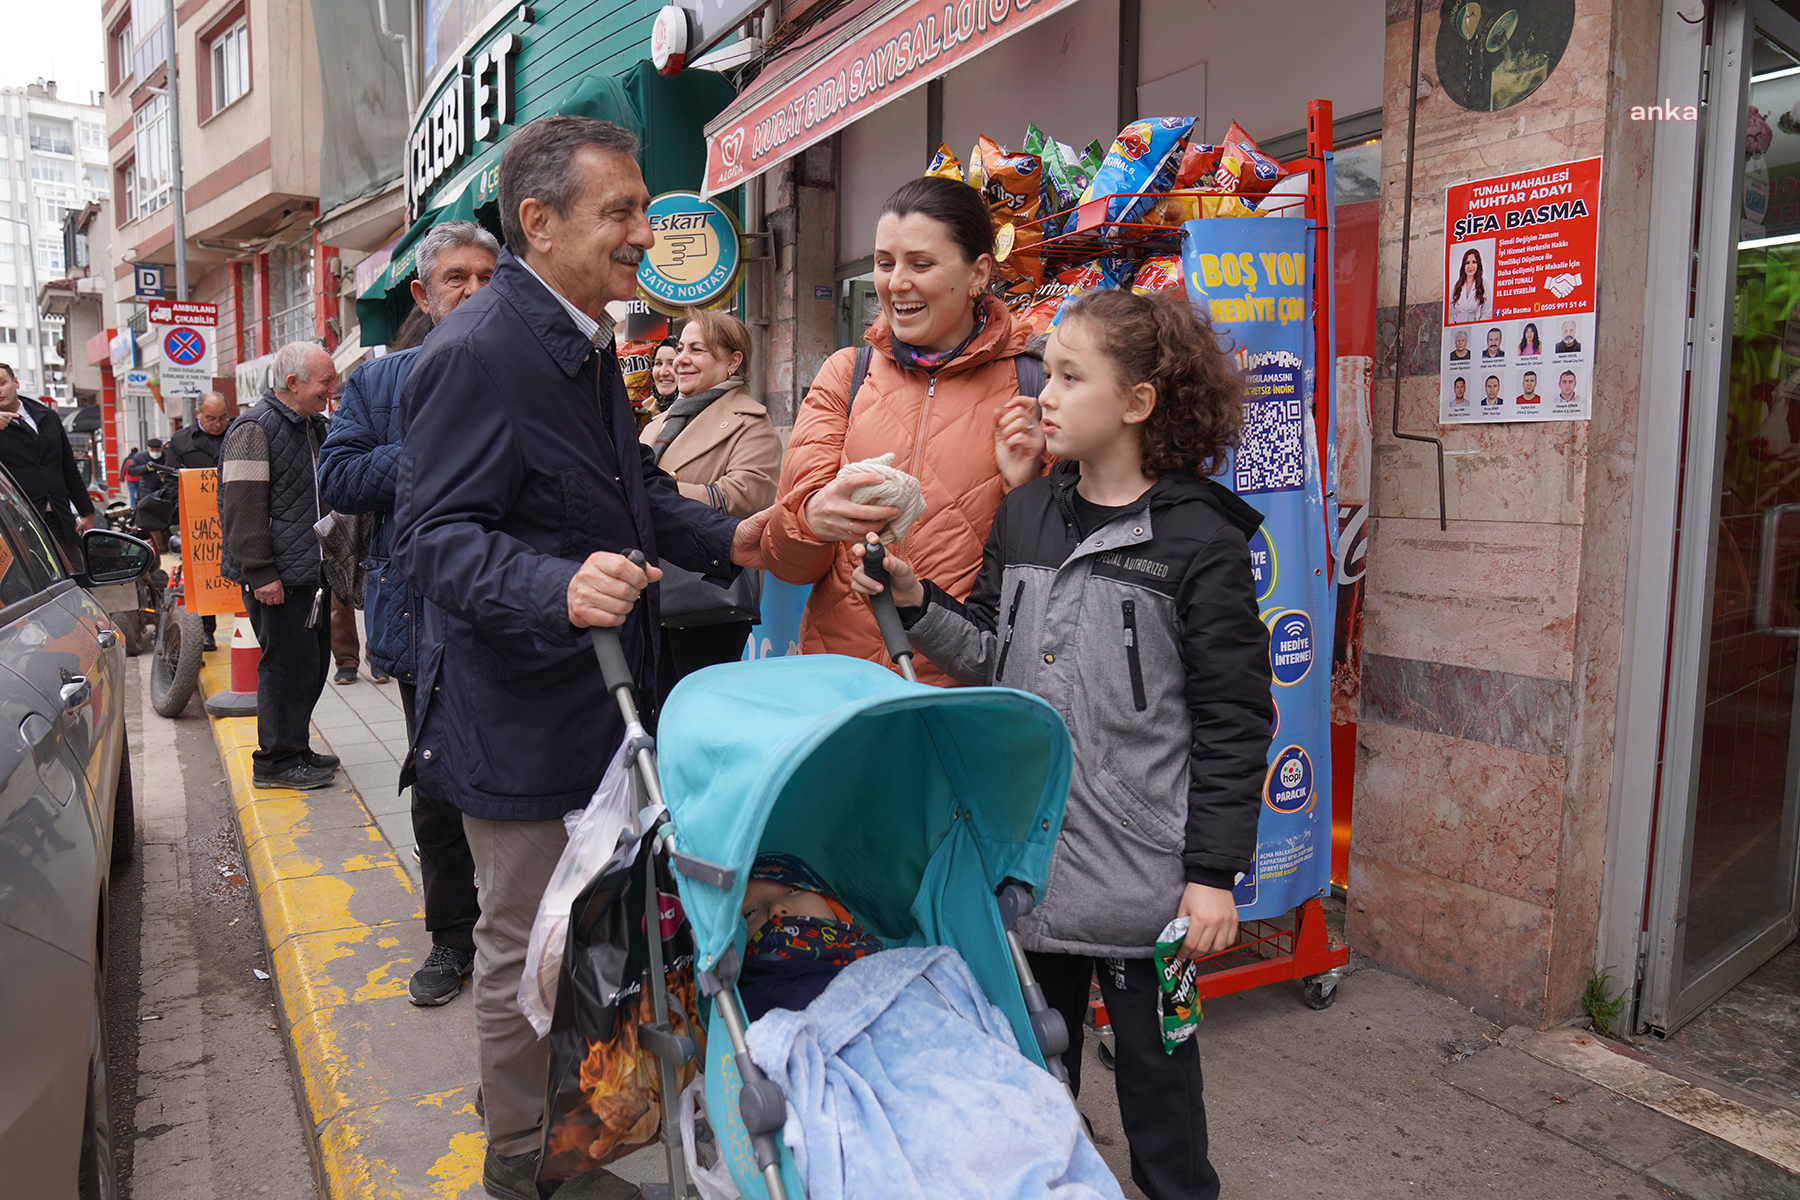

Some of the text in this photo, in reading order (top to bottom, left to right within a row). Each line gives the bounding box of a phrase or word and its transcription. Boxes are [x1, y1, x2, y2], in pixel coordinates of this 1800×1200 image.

[752, 95, 805, 160] MURAT
[848, 15, 941, 103] SAYISAL
[411, 56, 465, 220] ÇELEBİ
[474, 32, 515, 142] ET
[1473, 168, 1570, 198] TUNALI MAHALLESİ
[1469, 182, 1573, 211] MUHTAR ADAYI
[1454, 199, 1589, 241] ŞİFA BASMA
[1499, 237, 1515, 247] Şimdi
[1506, 246, 1526, 255] Hizmet
[1526, 243, 1551, 252] Herkesin
[1521, 254, 1545, 264] Düşünce
[1199, 252, 1257, 292] BOŞ
[1497, 268, 1512, 277] Daha
[1536, 264, 1544, 272] Bir
[1544, 261, 1568, 270] Mahalle
[144, 272, 156, 286] D
[640, 264, 728, 298] SATIŞ NOKTASI
[1514, 276, 1534, 285] TUNALI
[1503, 289, 1513, 297] ELE
[172, 304, 216, 314] AMBULANS
[1209, 294, 1275, 323] HEDİYE
[1513, 306, 1531, 315] Basma
[174, 314, 215, 325] ÇIKABİLİR
[1123, 557, 1169, 578] AUTHORIZED
[1280, 637, 1309, 653] HEDİYE
[1275, 650, 1312, 666] İNTERNET
[1283, 770, 1302, 783] hopi
[1276, 787, 1307, 803] PARACIK
